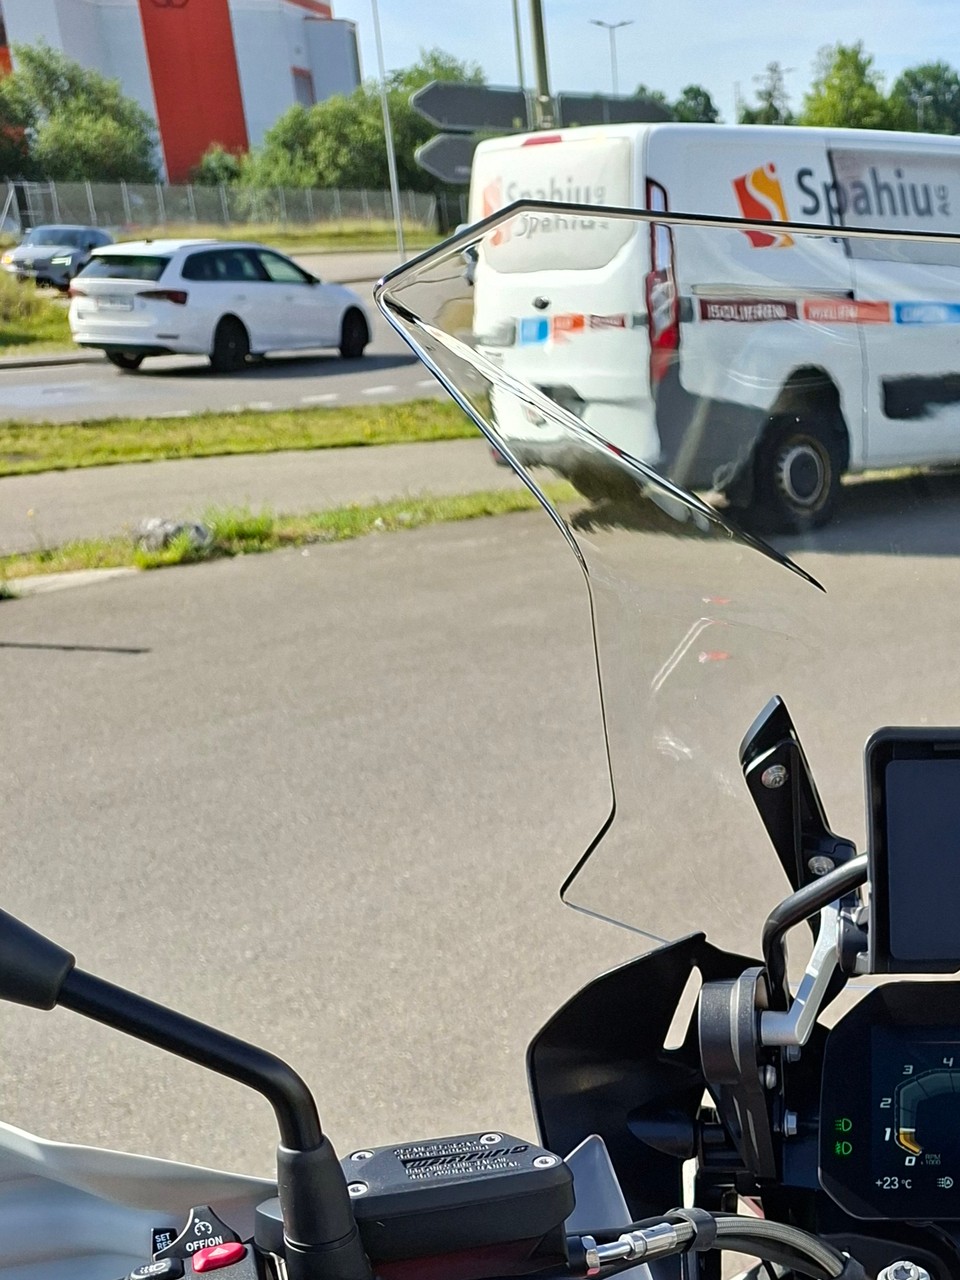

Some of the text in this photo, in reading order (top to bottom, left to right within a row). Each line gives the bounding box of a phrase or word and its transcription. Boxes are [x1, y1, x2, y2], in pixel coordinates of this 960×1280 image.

[797, 166, 934, 226] Spahiu
[943, 1057, 954, 1067] 4
[902, 1065, 914, 1075] 3
[879, 1098, 892, 1108] 2
[884, 1128, 892, 1141] 1
[904, 1156, 916, 1166] 0
[875, 1177, 899, 1189] +23
[154, 1232, 171, 1244] SET
[186, 1235, 224, 1252] OFF/ON
